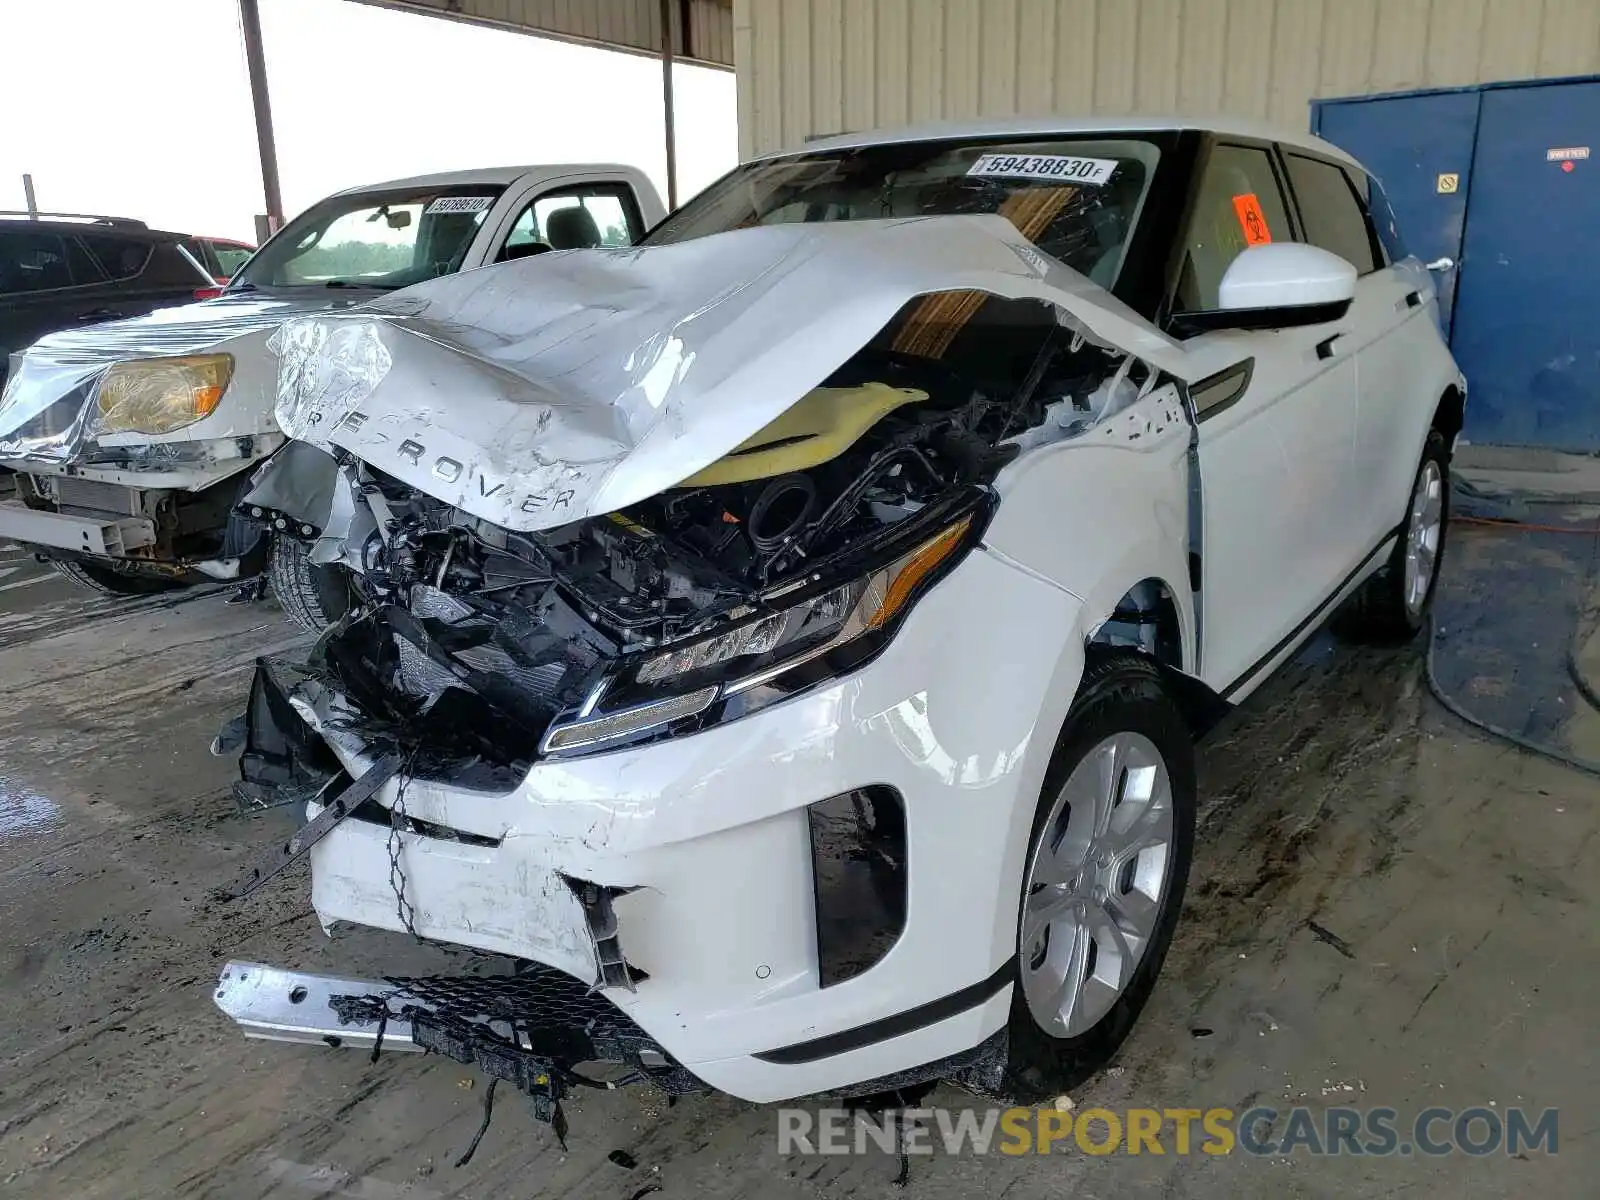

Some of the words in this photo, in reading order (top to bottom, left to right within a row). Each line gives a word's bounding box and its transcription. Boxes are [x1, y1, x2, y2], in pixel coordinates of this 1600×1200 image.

[987, 156, 1094, 178] 59438830
[1093, 168, 1103, 177] F
[397, 438, 575, 513] ROVER
